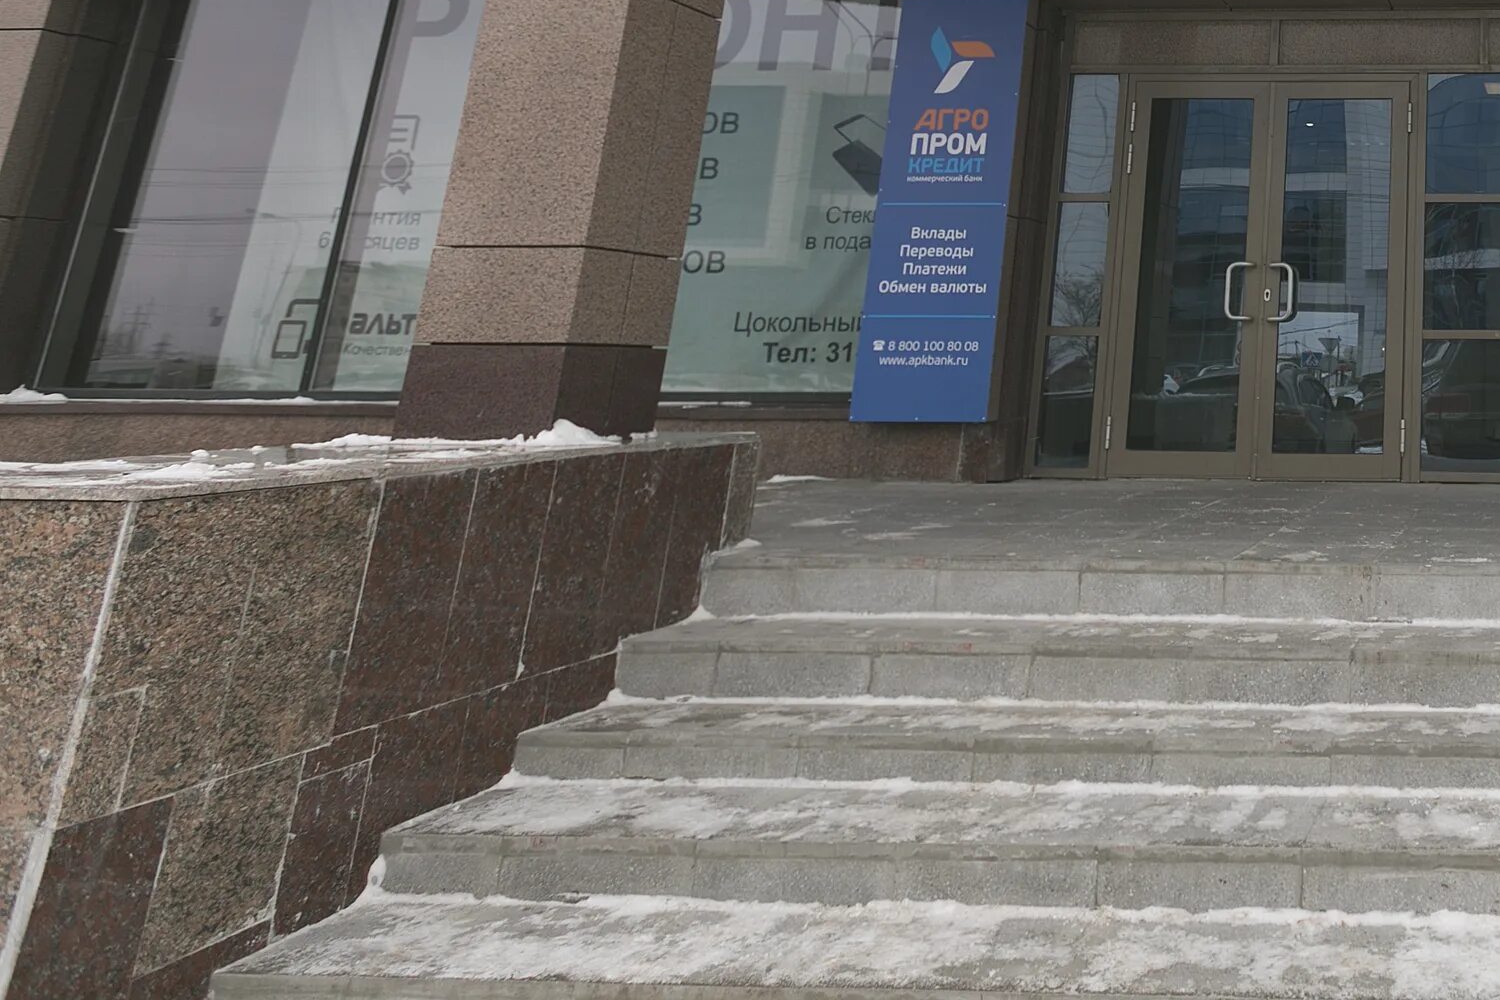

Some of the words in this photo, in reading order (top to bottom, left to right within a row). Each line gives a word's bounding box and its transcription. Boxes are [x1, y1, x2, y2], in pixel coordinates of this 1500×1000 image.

[912, 108, 989, 131] АГРО
[910, 132, 987, 155] ПРОМ
[907, 157, 985, 173] КРЕДИТ
[964, 174, 983, 182] банк
[911, 227, 967, 241] Вклады
[900, 244, 974, 259] Переводы
[902, 262, 967, 275] Платежи
[878, 280, 926, 293] Обмен
[930, 282, 987, 294] валюты
[763, 342, 816, 363] Тел:
[887, 340, 896, 351] 8
[898, 340, 920, 351] 800
[923, 340, 944, 351] 100
[947, 340, 962, 351] 80
[964, 340, 979, 351] 08
[879, 355, 969, 368] www.apkbank.ru
